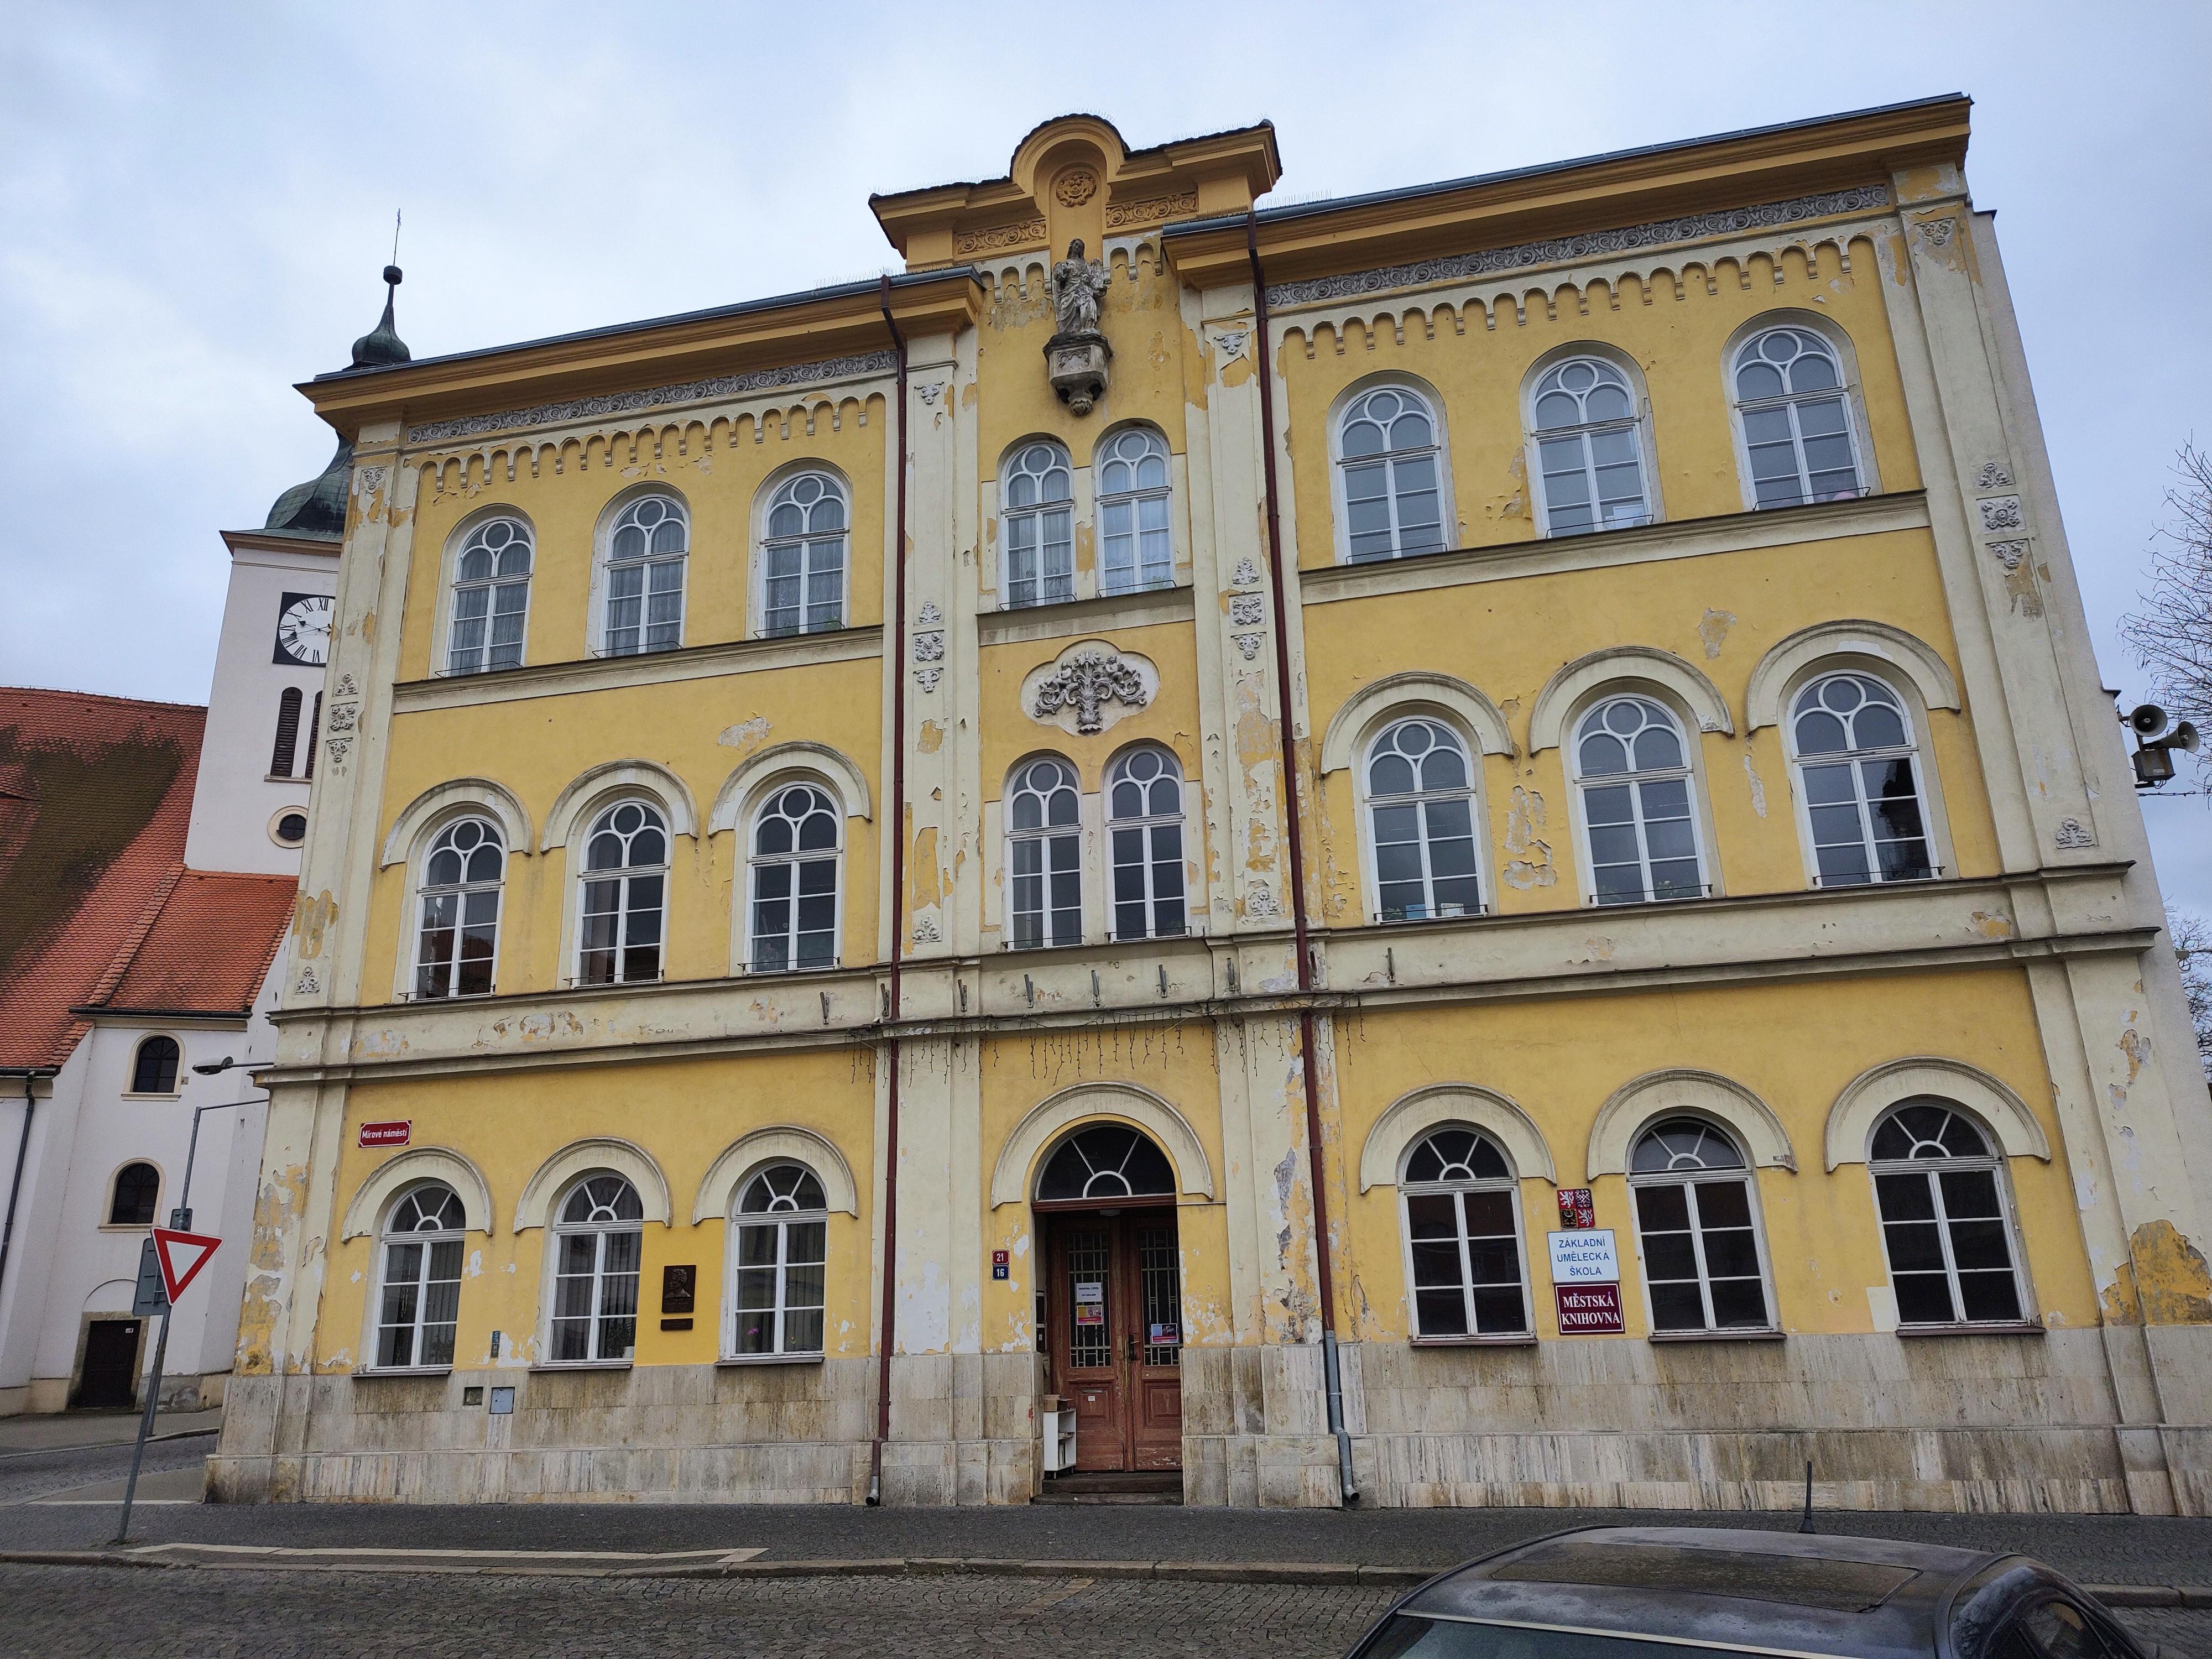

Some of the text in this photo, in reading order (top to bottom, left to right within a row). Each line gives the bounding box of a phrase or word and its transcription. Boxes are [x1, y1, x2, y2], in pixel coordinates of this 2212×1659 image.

[300, 599, 314, 613] XI
[317, 598, 329, 611] XII
[286, 609, 302, 620] X
[293, 644, 307, 659] VII
[312, 649, 320, 662] VI
[362, 1128, 408, 1139] Mírové náměstí
[1559, 1235, 1605, 1248] ZÁKLADNÍ
[997, 1253, 1004, 1261] 21
[1557, 1250, 1610, 1262] UMĚLECKÁ
[997, 1269, 1004, 1277] 16
[1570, 1266, 1602, 1276] ŠKOLA
[1563, 1291, 1615, 1307] MĚSTSKÁ
[1561, 1312, 1621, 1325] KNIHOVNA
